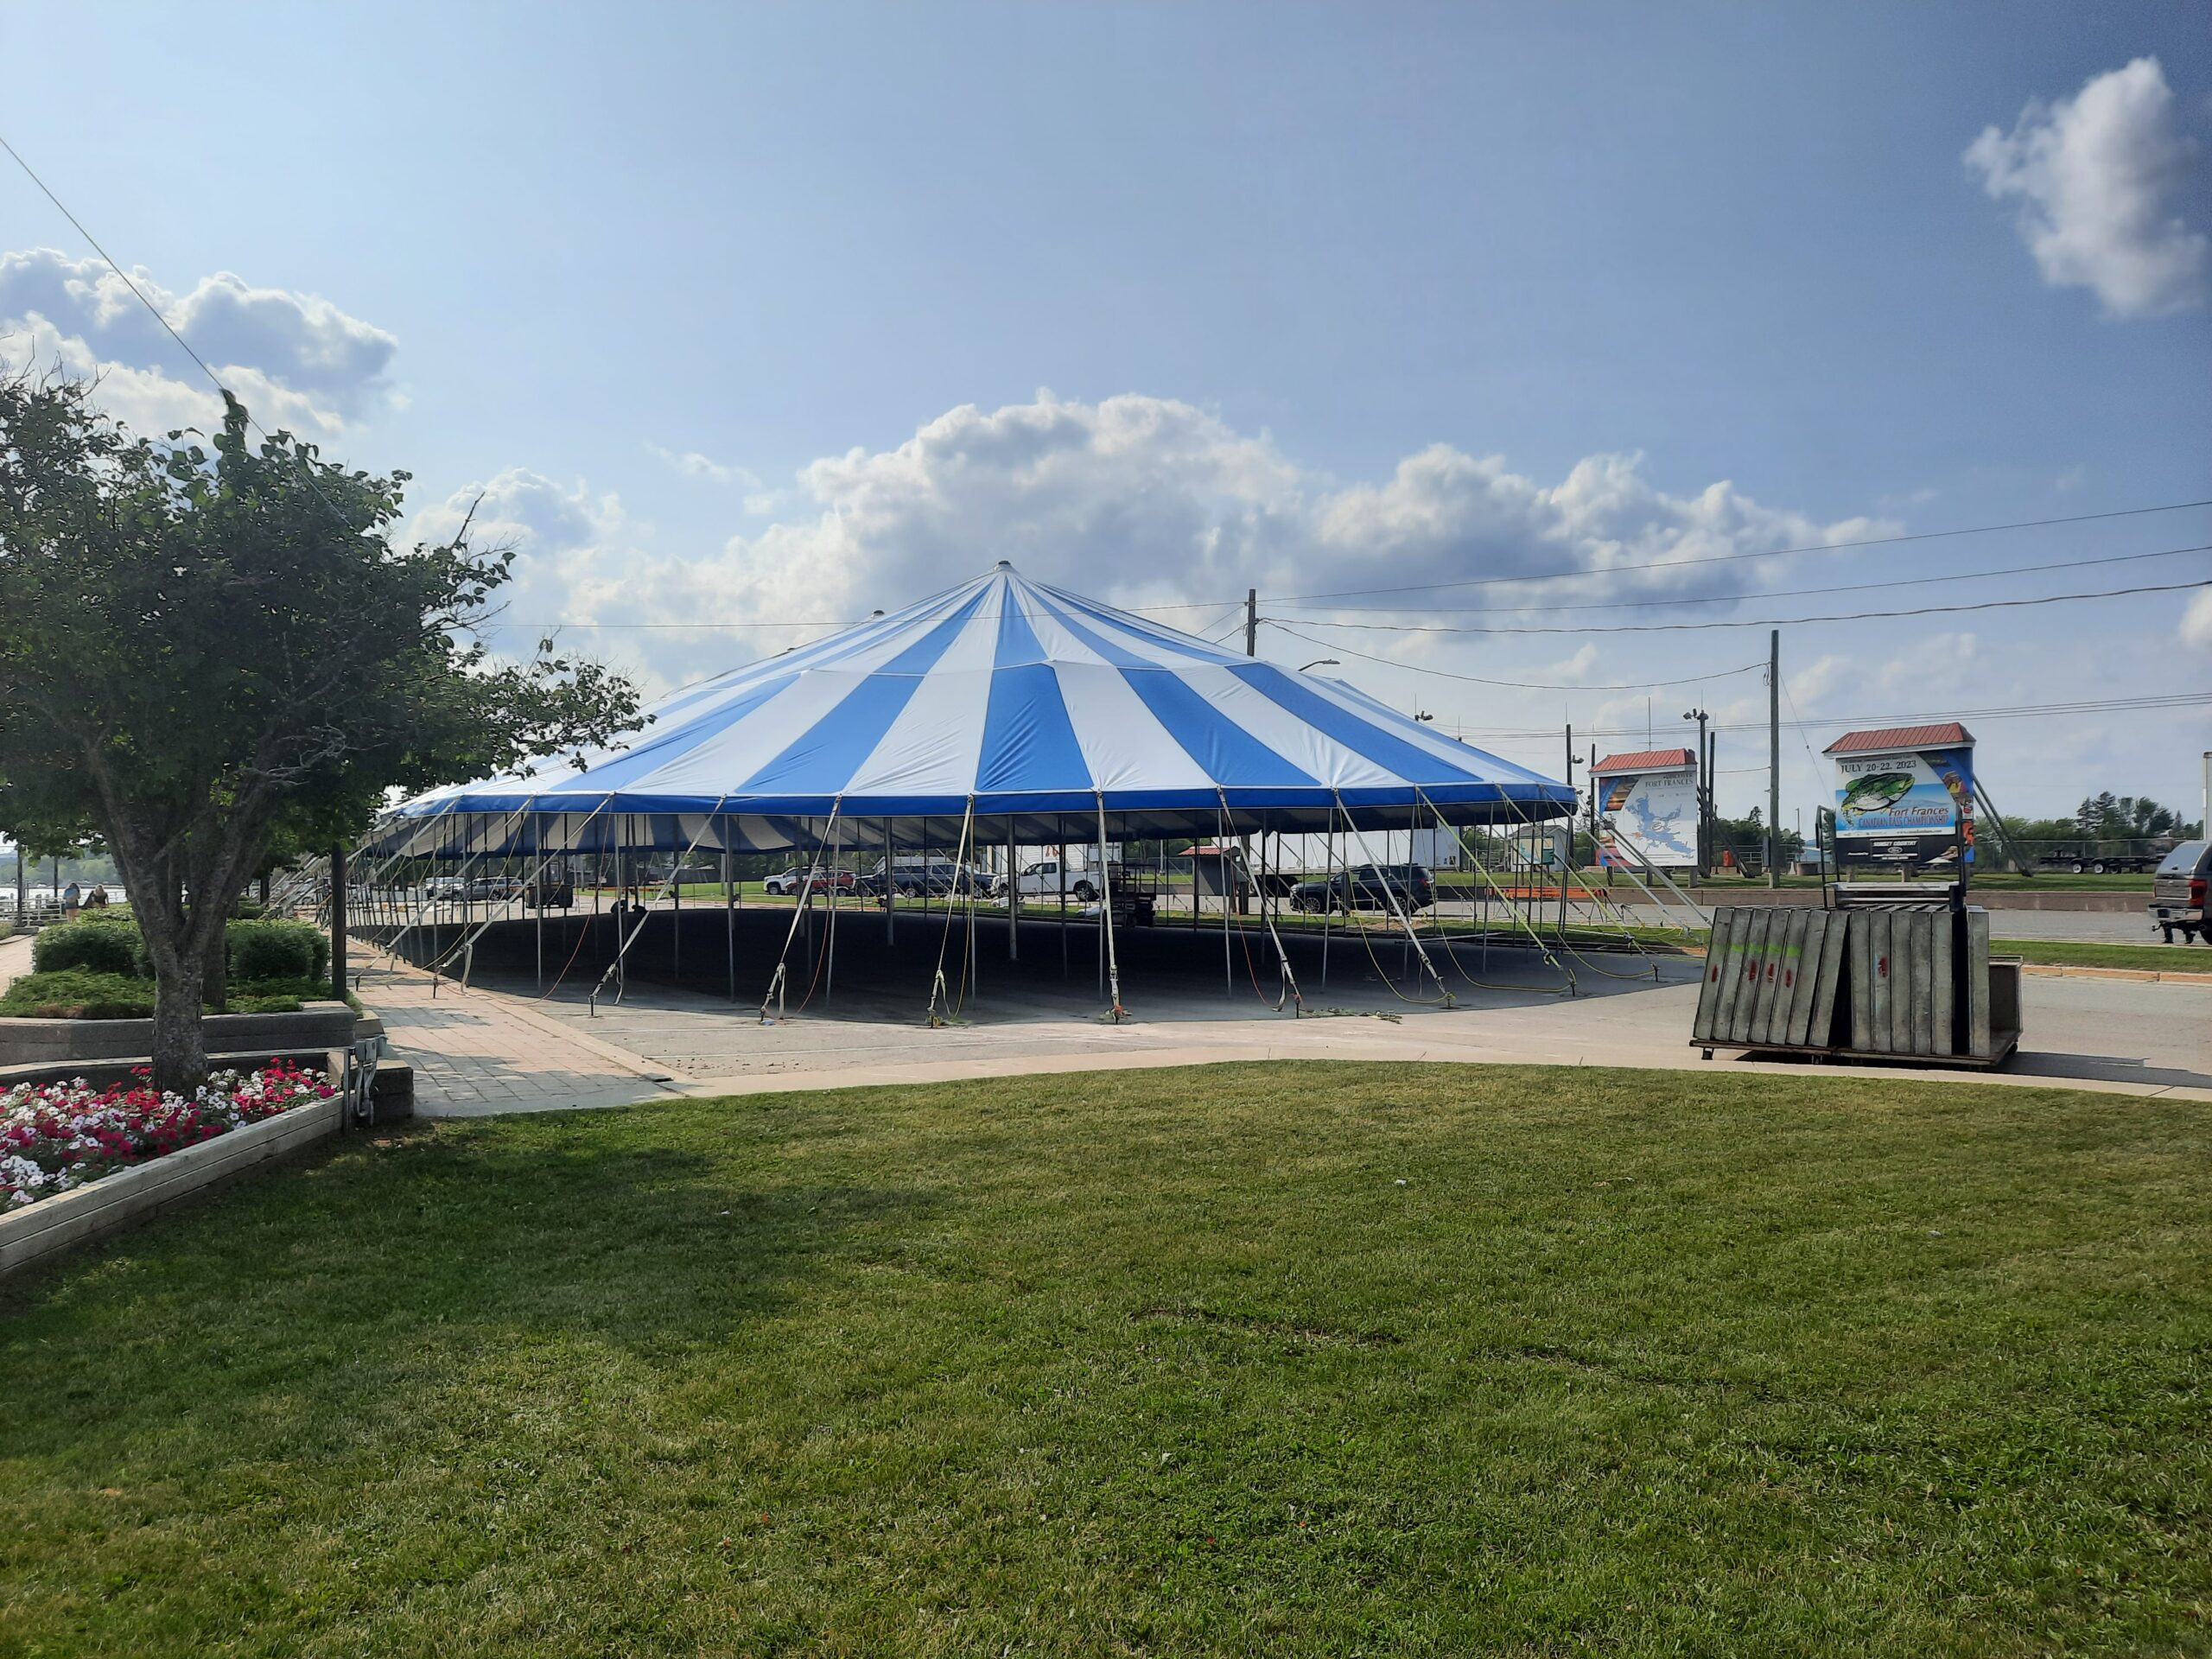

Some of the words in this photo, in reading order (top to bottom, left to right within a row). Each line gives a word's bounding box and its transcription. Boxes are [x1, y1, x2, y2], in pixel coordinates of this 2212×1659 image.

[1840, 764, 1862, 773] JULY
[1896, 760, 1916, 769] 2023
[1663, 778, 1694, 786] FRANCES
[1889, 808, 1908, 817] Fort
[1911, 806, 1949, 816] Frances
[1904, 816, 1949, 825] CHAMPIONSHIP
